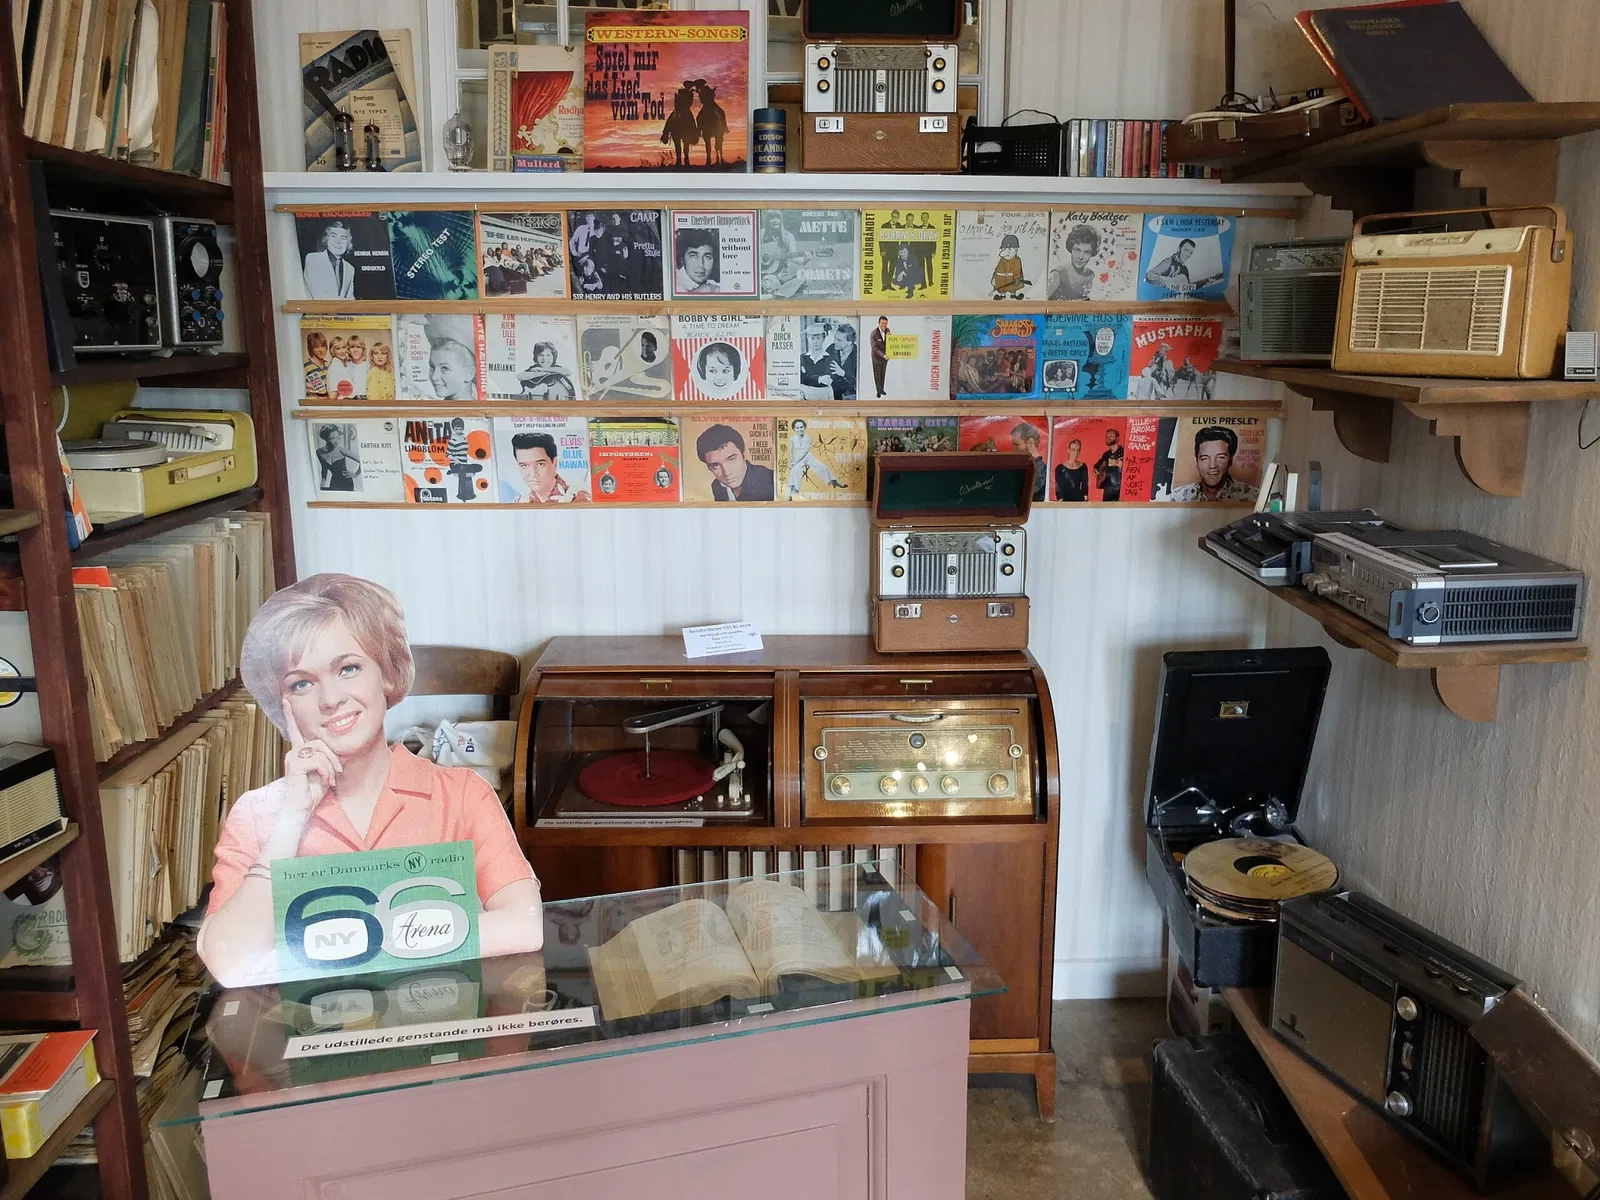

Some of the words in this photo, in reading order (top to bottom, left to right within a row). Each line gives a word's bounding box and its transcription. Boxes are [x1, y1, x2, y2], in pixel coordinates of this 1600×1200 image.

[595, 28, 739, 40] WESTERN-SONGS
[596, 44, 630, 74] Spiel
[634, 44, 660, 70] mir
[303, 37, 388, 106] RADIO
[586, 73, 608, 100] das
[612, 72, 641, 100] Lied
[612, 100, 639, 120] vom
[642, 92, 666, 120] Tod
[517, 160, 560, 168] Mullard
[630, 212, 660, 222] CAMP
[691, 216, 715, 226] Engelbert
[1066, 212, 1090, 223] Katy
[800, 221, 847, 233] METTE
[863, 212, 875, 257] HÅRBÅNDET
[633, 242, 655, 252] Pretty
[942, 241, 950, 260] BYGGE
[407, 248, 434, 279] STEREO
[432, 228, 451, 248] TEST
[864, 260, 873, 270] OG
[864, 273, 873, 294] PIGEN
[940, 272, 949, 295] VERDEN
[1046, 314, 1089, 322] HJEMME
[1134, 324, 1212, 348] MUSTAPHA
[772, 342, 793, 350] PASSER
[932, 330, 940, 362] INGMANN
[489, 363, 516, 372] MARIANNE
[1131, 425, 1156, 433] BRORS
[405, 445, 445, 453] LINDBLOM
[563, 450, 583, 459] BLUE
[559, 461, 588, 469] HAWAII
[284, 871, 307, 880] her
[329, 860, 400, 875] Danmarks
[407, 856, 421, 870] NY
[430, 854, 465, 865] radio
[314, 930, 358, 948] NY
[386, 912, 452, 948] Arena
[301, 1041, 320, 1052] De
[324, 1034, 393, 1050] udstillede
[397, 1027, 468, 1043] genstande
[472, 1024, 493, 1034] må
[497, 1021, 525, 1032] ikke
[529, 1015, 582, 1028] berøres.
